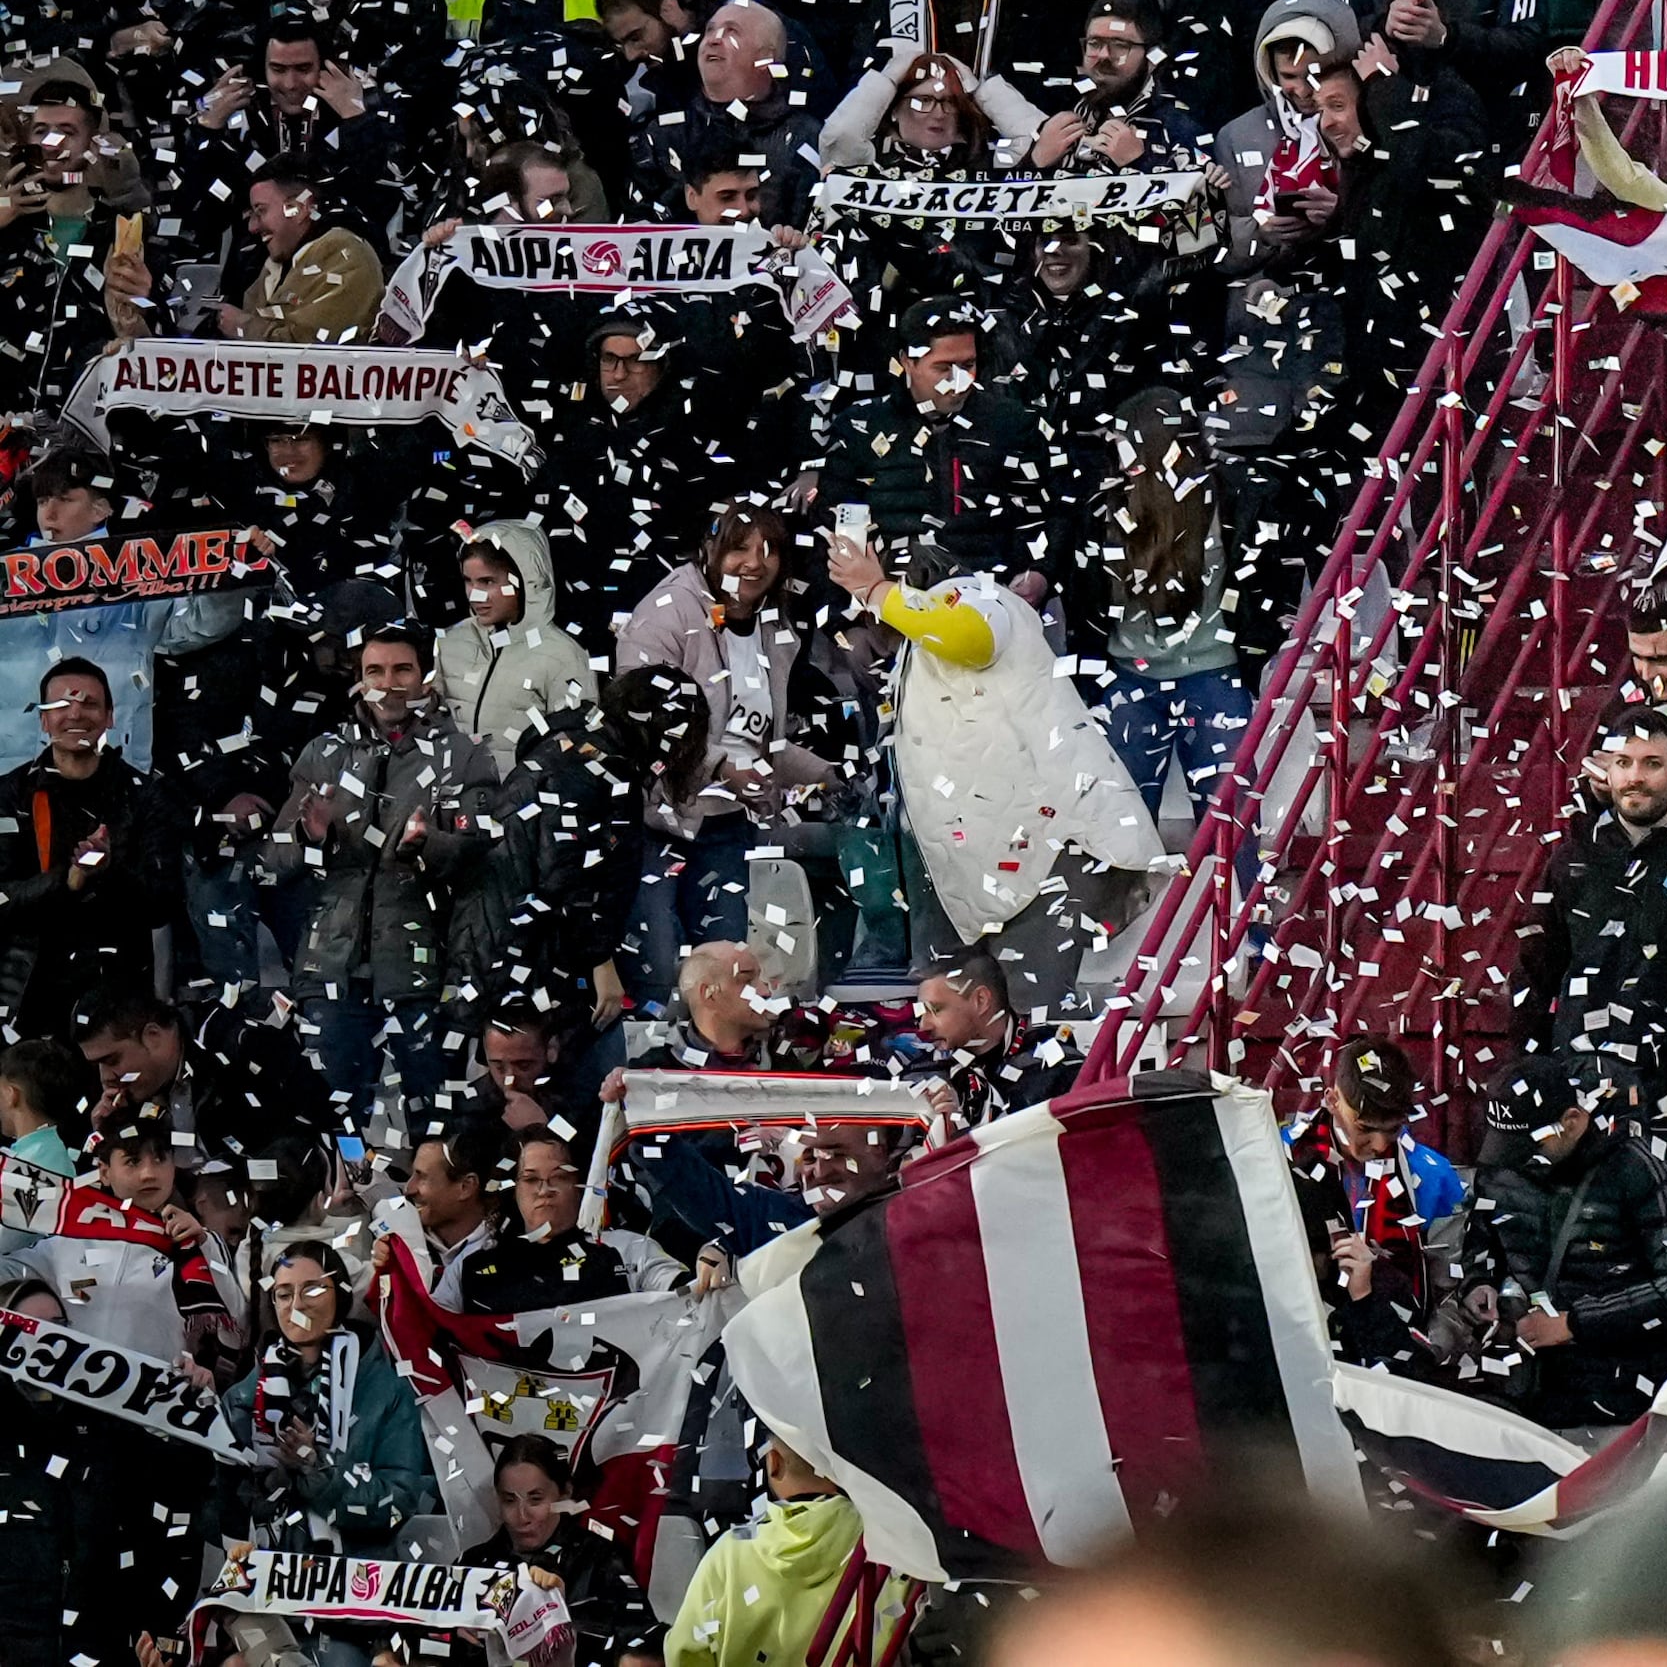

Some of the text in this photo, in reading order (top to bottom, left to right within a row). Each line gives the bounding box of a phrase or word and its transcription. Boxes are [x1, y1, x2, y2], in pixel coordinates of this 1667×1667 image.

[976, 171, 1043, 183] EL ALBA
[843, 184, 1057, 213] ALBACETE
[993, 220, 1033, 232] ALBA
[113, 357, 284, 398] ALBACETE
[3, 528, 269, 597] ROMMEL
[381, 1562, 471, 1611] ALBA
